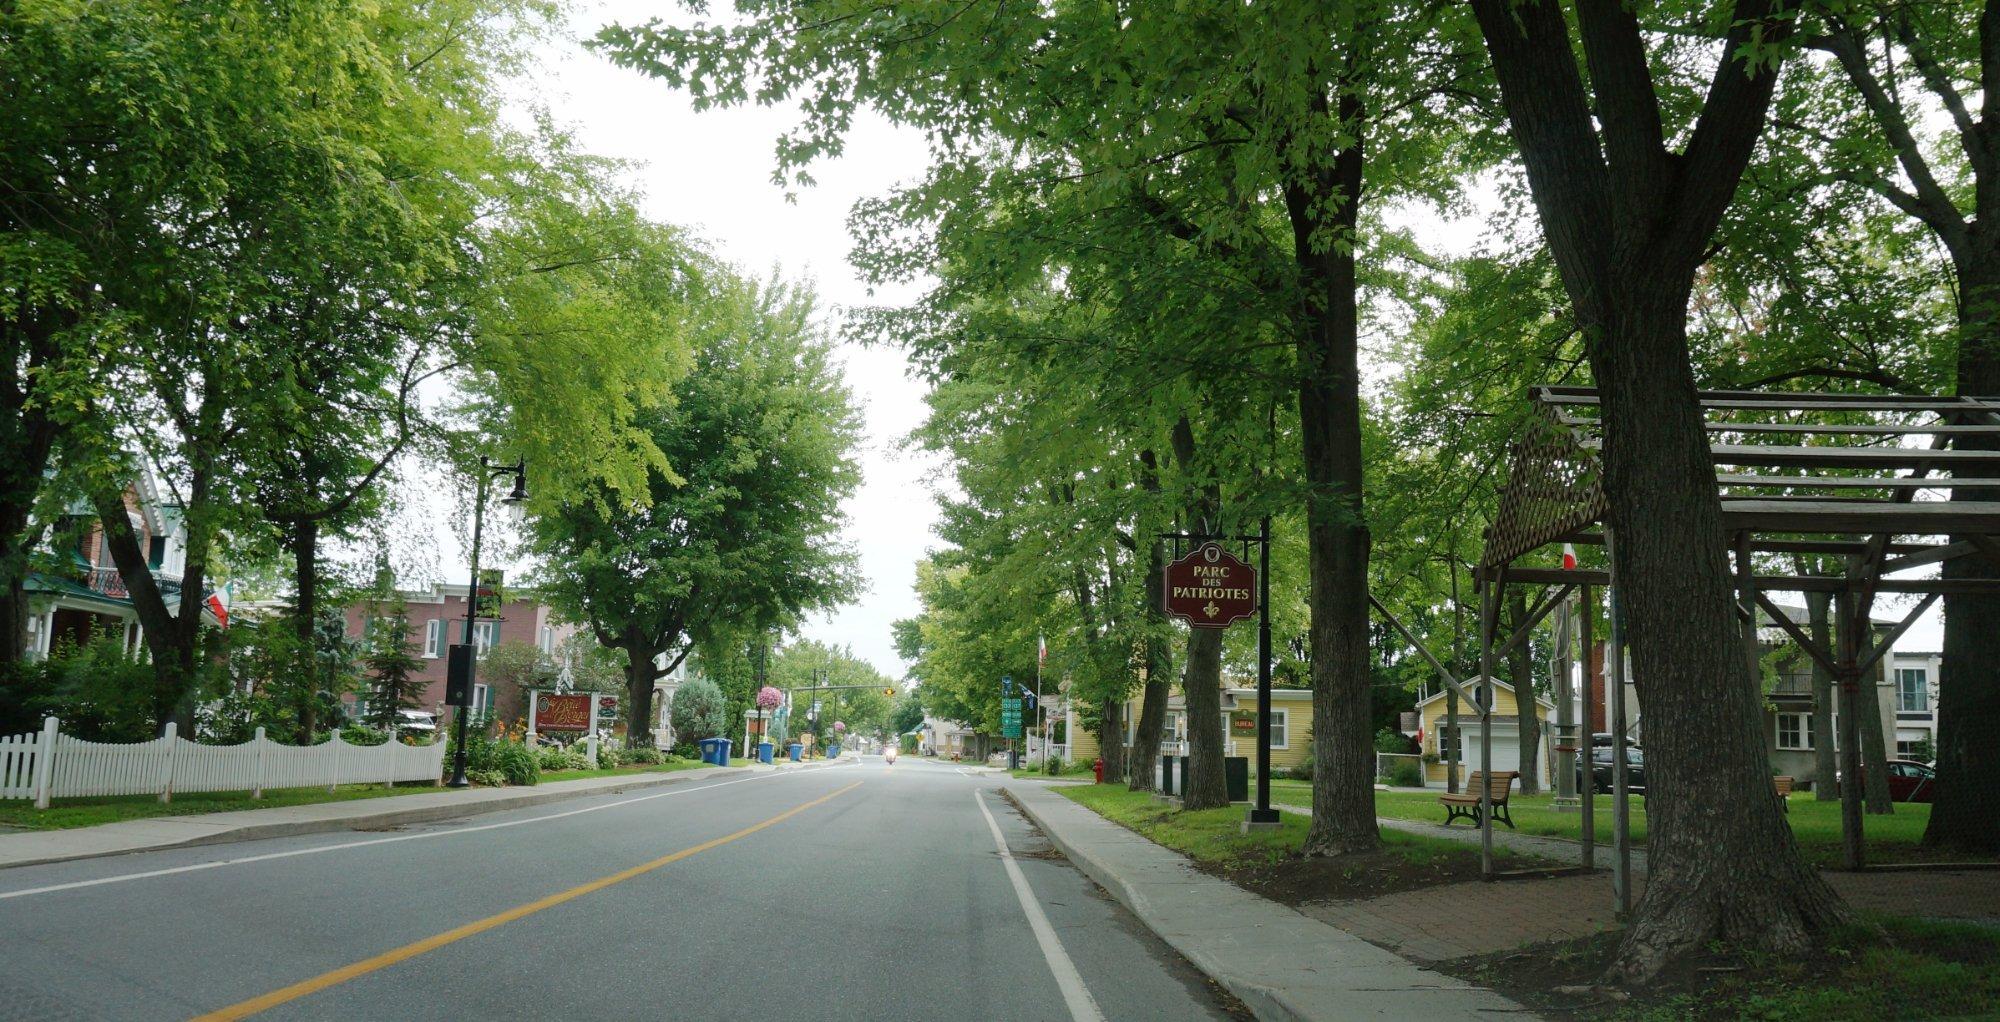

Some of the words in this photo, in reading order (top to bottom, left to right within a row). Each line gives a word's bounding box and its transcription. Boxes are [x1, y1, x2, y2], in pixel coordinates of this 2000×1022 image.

[1193, 565, 1230, 578] PARC
[1202, 578, 1222, 587] DES
[1173, 586, 1249, 600] PATRIOTES
